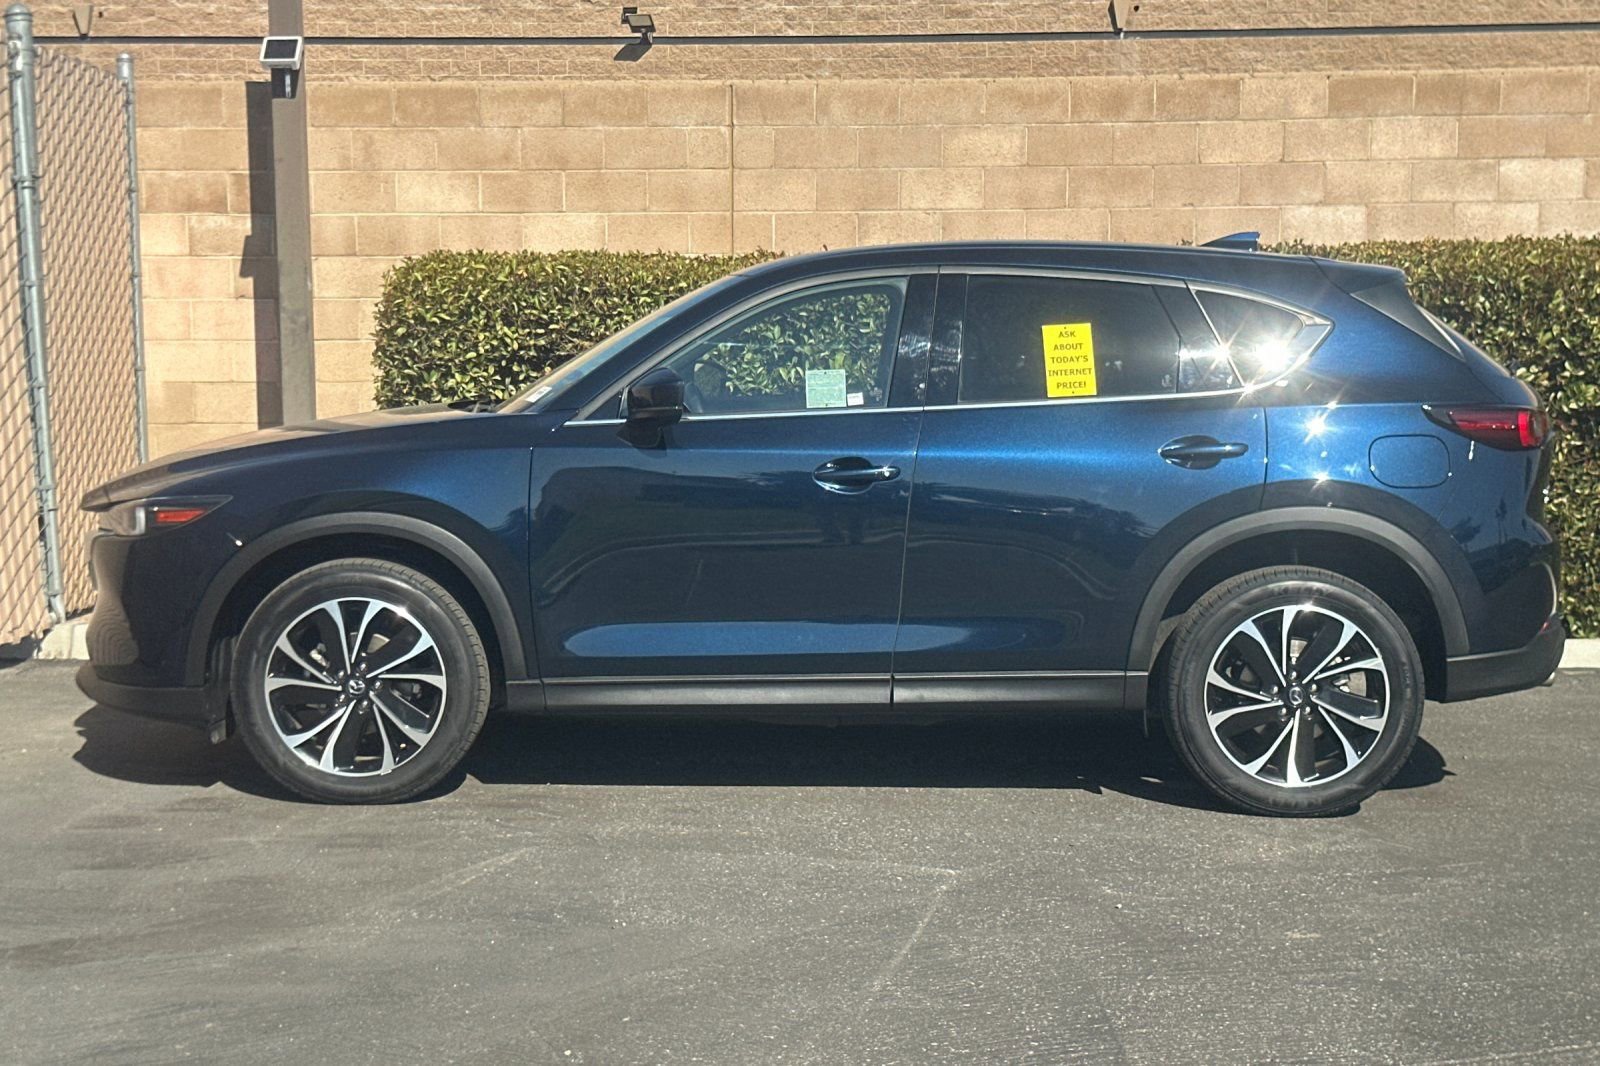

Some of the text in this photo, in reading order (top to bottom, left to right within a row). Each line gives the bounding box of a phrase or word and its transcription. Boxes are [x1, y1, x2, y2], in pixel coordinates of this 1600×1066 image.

[1058, 330, 1076, 338] ASK
[1053, 343, 1083, 351] ABOUT
[1050, 355, 1089, 364] TODAY'S
[1048, 368, 1092, 377] INTERNET
[1056, 381, 1087, 389] PRICE!
